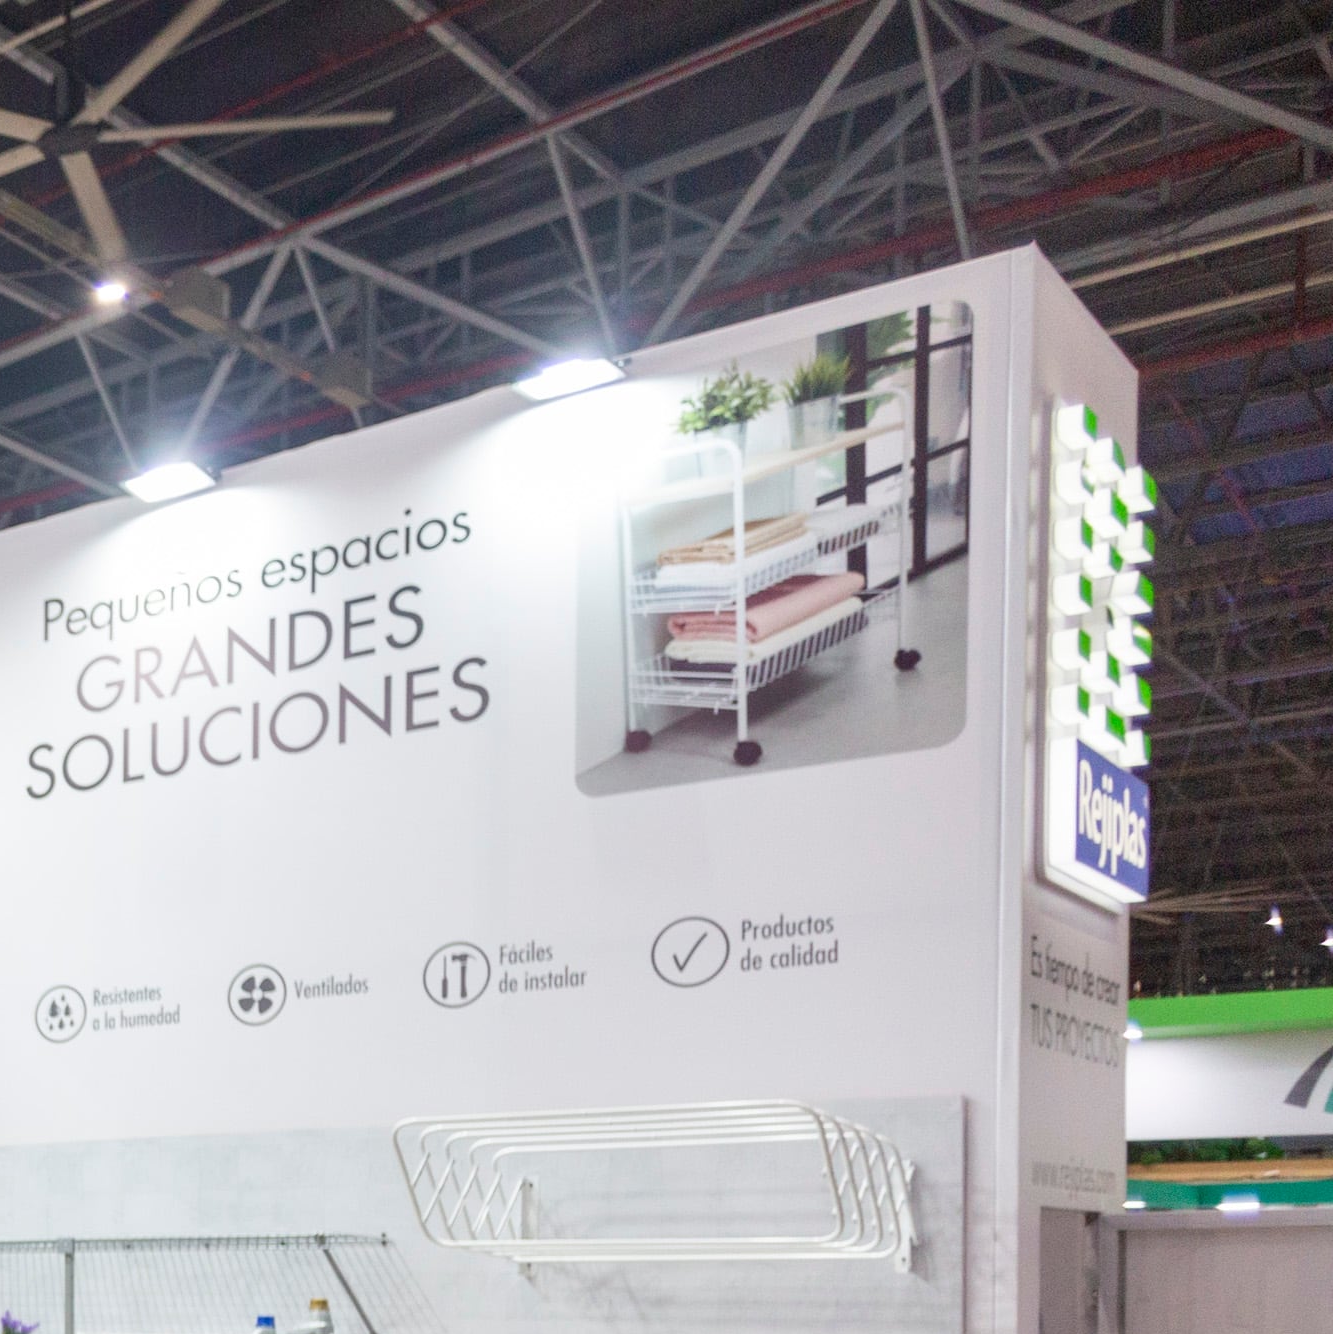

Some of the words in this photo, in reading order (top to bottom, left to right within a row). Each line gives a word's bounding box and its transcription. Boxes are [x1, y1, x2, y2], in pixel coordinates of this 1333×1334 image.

[260, 508, 473, 593] espacios
[75, 584, 426, 713] GRANDES
[25, 656, 491, 800] SOLUCIONES
[741, 913, 835, 942] Productos
[499, 939, 553, 966] Fáciles
[740, 948, 763, 972] de
[770, 939, 839, 970] calidad
[294, 973, 369, 1000] Ventilados
[498, 971, 518, 994] de
[524, 965, 587, 992] instalar
[93, 986, 162, 1007] Resistentes
[92, 1018, 100, 1031] a
[104, 1011, 116, 1030] la
[120, 1004, 181, 1029] humedad
